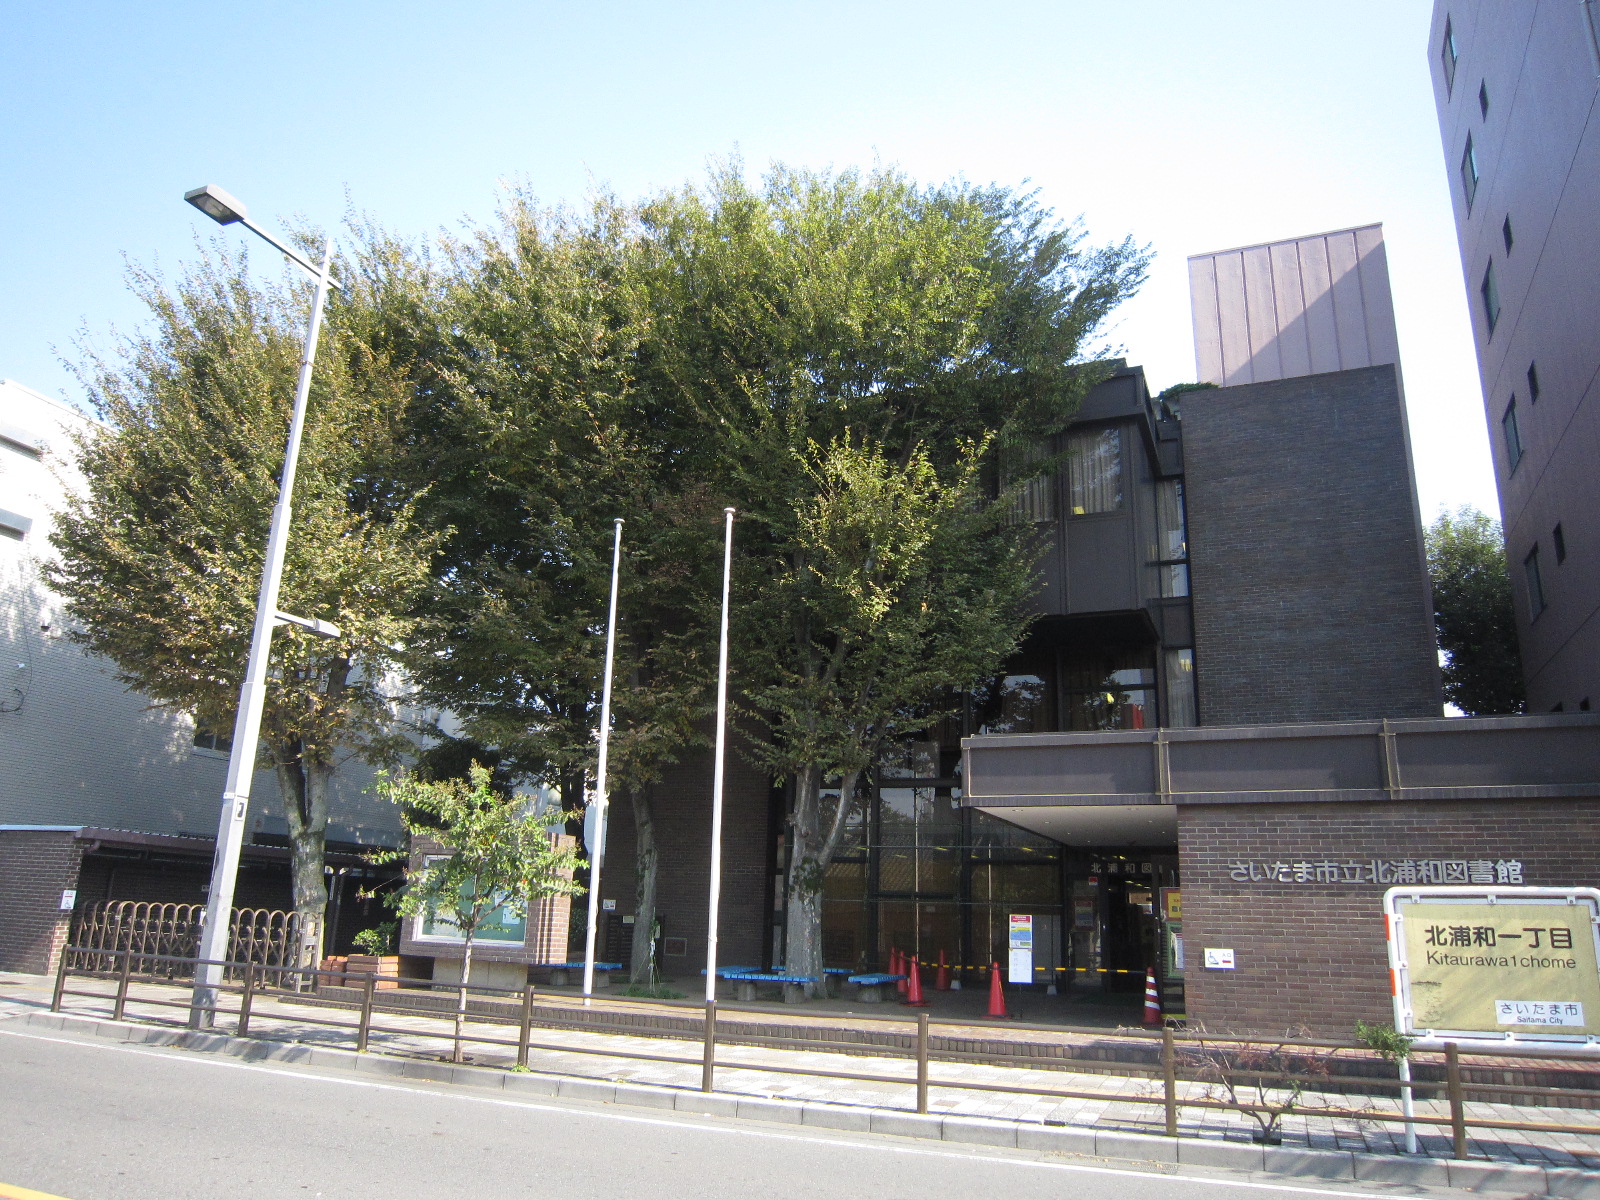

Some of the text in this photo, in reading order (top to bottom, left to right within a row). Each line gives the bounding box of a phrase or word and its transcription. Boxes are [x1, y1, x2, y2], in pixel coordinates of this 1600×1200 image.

[1091, 862, 1163, 874] 北浦和図
[1228, 859, 1523, 884] さいたま市立北浦和図書館
[1424, 925, 1573, 949] 北浦和一丁目
[1501, 1003, 1578, 1016] さいたま市
[1517, 1016, 1563, 1025] Saitama City
